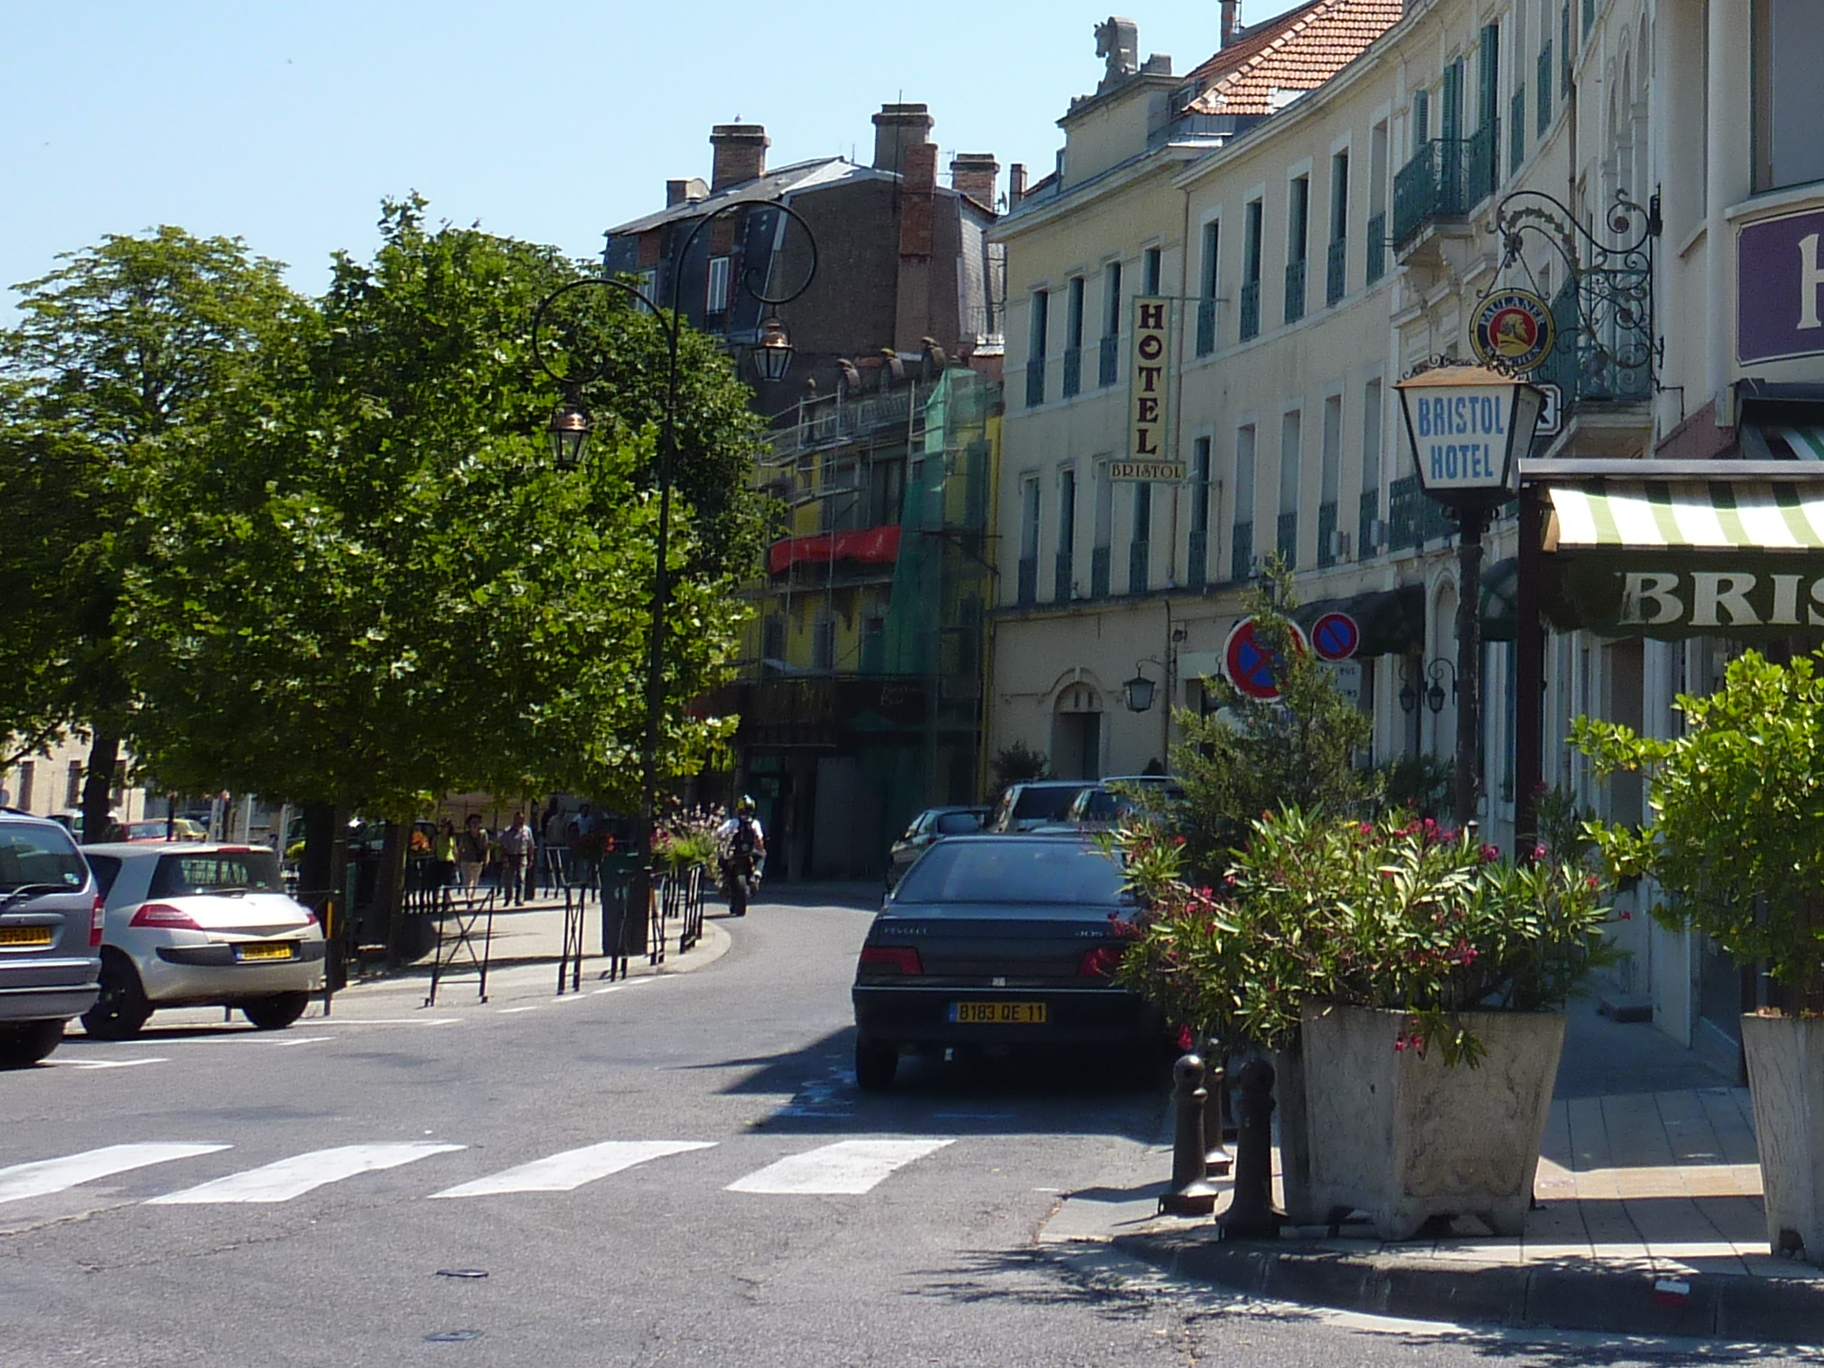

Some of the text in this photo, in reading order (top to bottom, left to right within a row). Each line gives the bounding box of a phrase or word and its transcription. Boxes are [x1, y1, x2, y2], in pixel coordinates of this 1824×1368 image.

[1479, 297, 1547, 326] PAULANER
[1136, 304, 1164, 455] HOTEL
[1418, 396, 1504, 437] BRISTOL
[1112, 463, 1181, 479] BRISTOL
[1431, 443, 1494, 480] HOTEL
[959, 1005, 1043, 1020] 8183 QE 11
